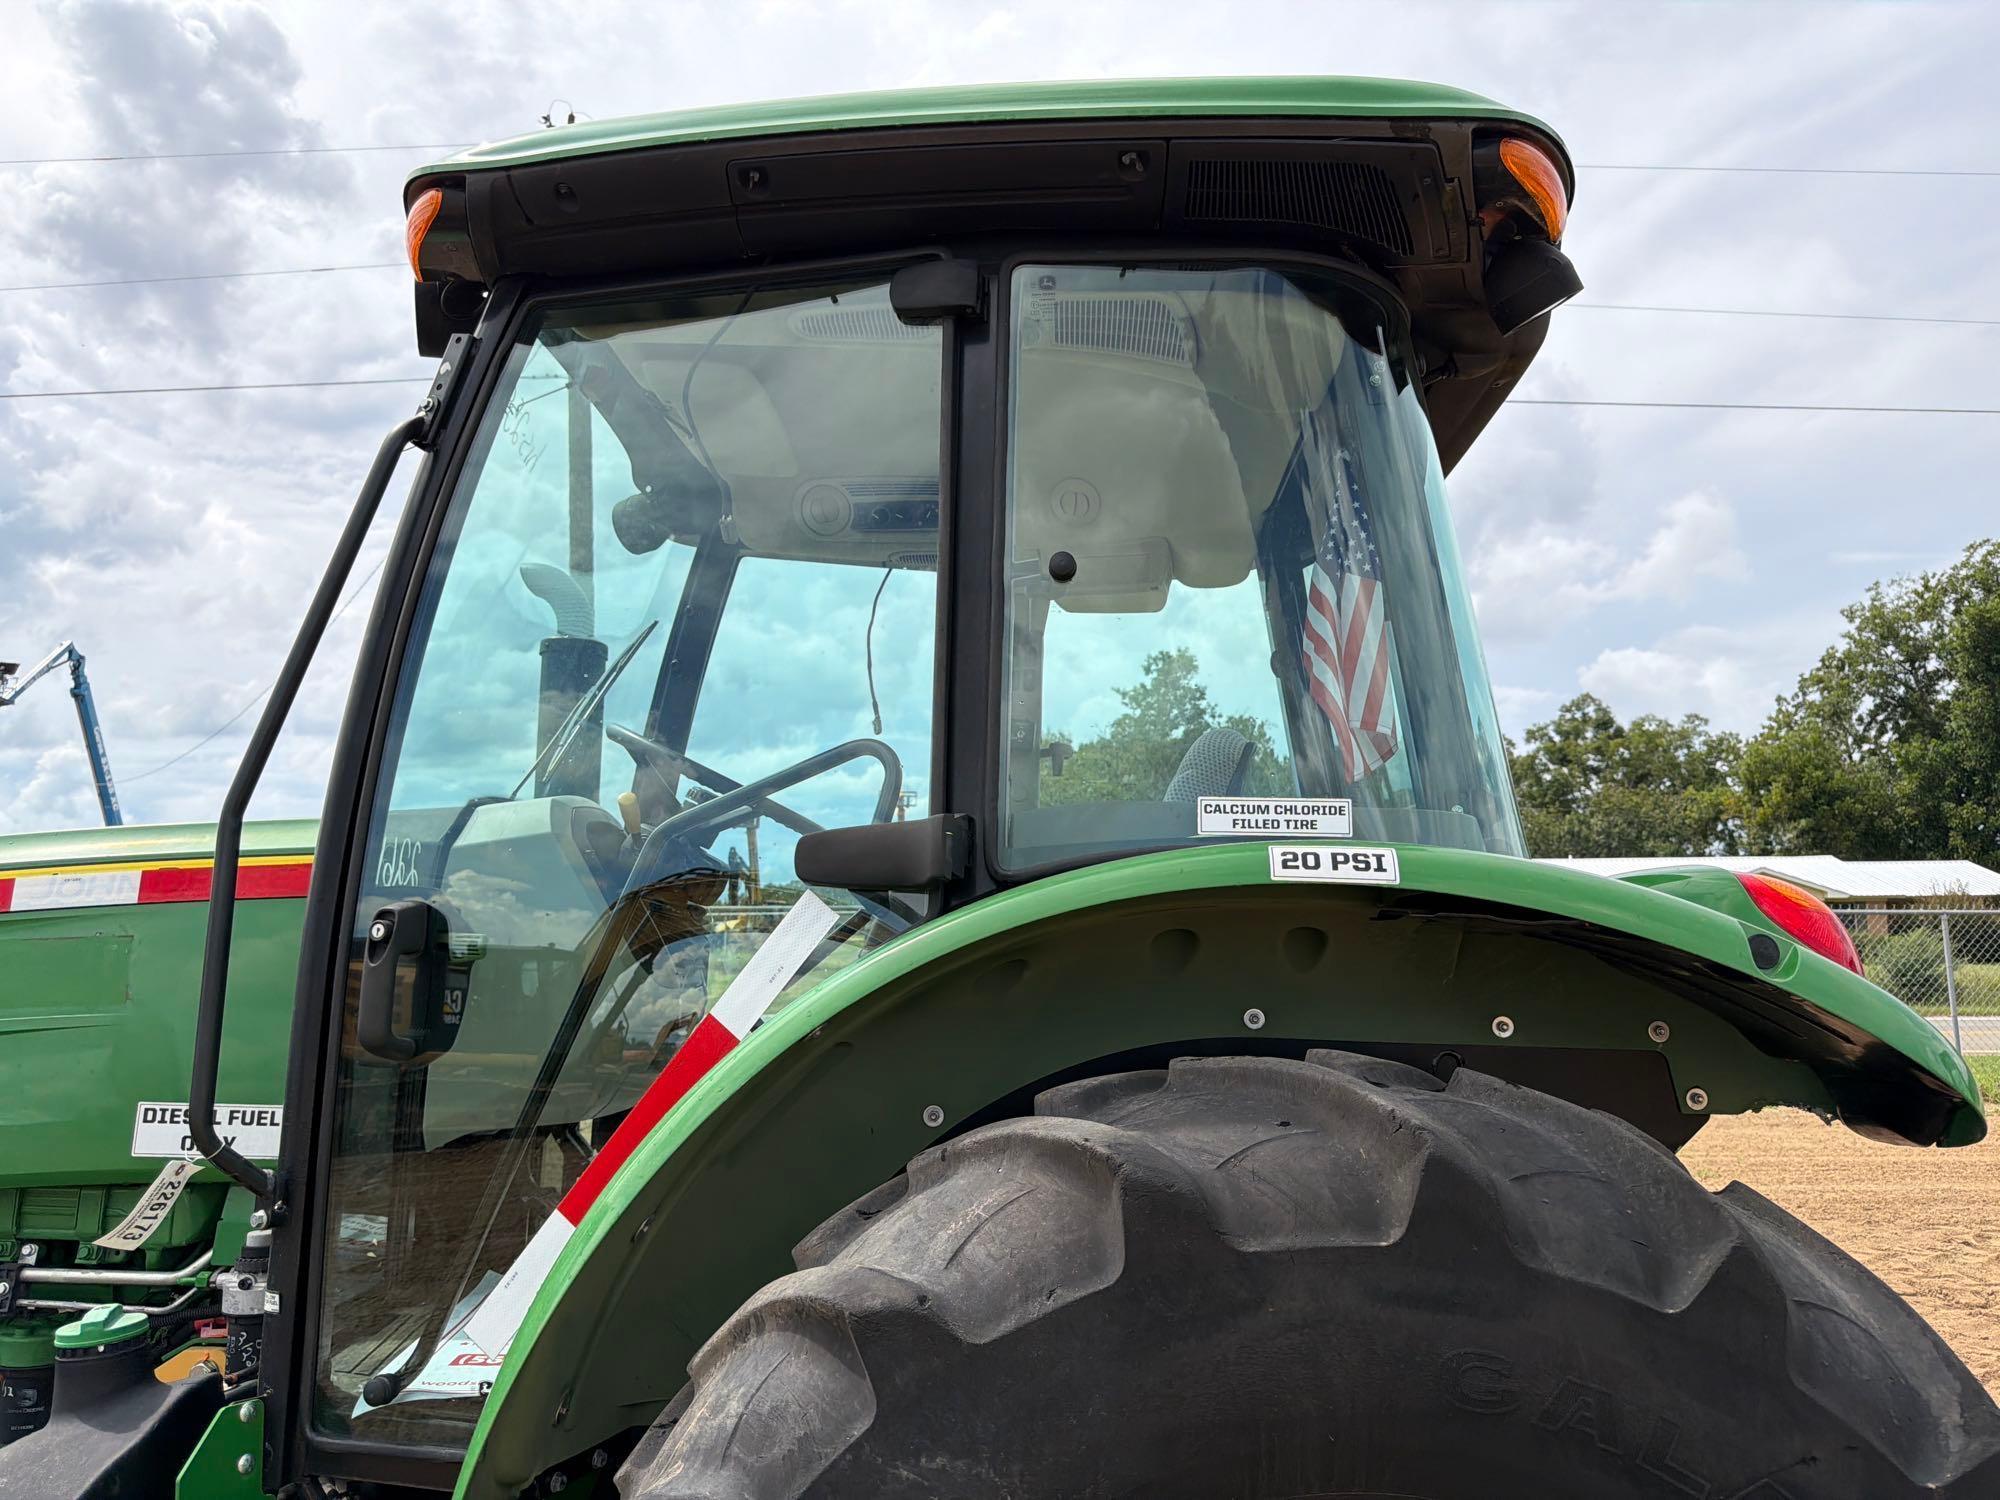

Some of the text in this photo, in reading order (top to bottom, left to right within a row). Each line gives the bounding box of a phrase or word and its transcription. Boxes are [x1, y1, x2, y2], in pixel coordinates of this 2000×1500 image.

[1203, 803, 1347, 817] CALCIUM CHLORIDE
[1232, 818, 1318, 830] FILLED TIRE
[1281, 851, 1387, 873] 20 PSI
[142, 1107, 280, 1127] DIESL FUEL
[180, 1135, 237, 1152] OY
[121, 1180, 182, 1241] 226173
